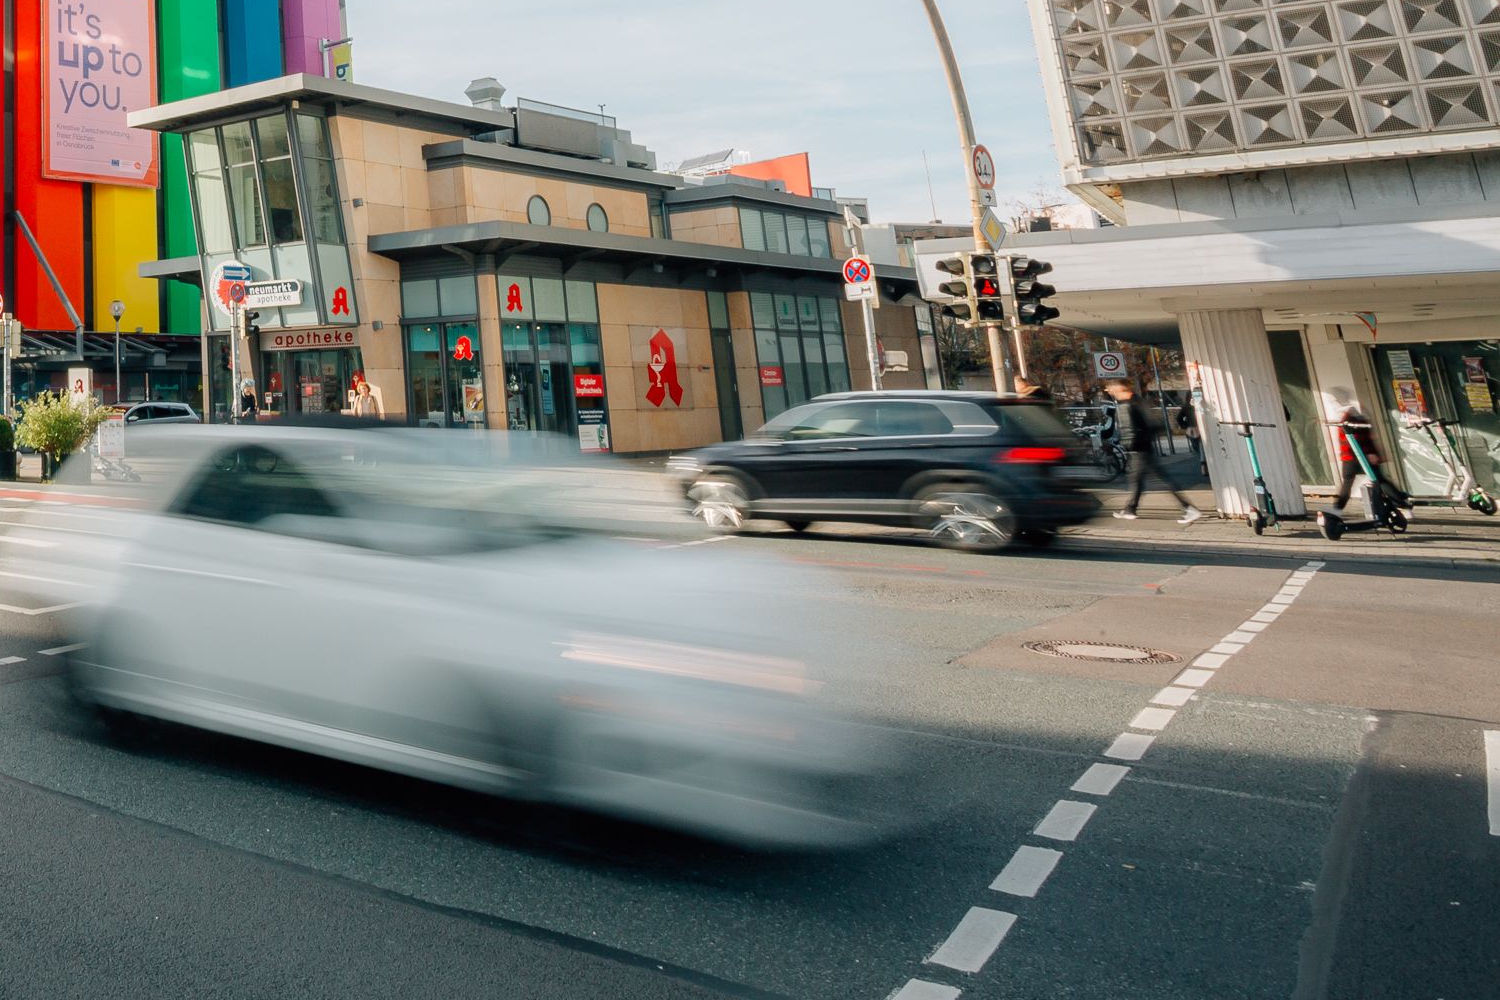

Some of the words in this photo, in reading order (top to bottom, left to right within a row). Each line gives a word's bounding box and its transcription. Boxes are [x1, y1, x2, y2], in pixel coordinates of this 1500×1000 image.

[58, 41, 104, 79] up
[108, 44, 143, 77] to
[58, 78, 127, 113] you.
[250, 282, 292, 295] neumarkt
[257, 294, 292, 304] apotheke
[274, 330, 355, 347] apotheke
[1104, 358, 1116, 367] 20
